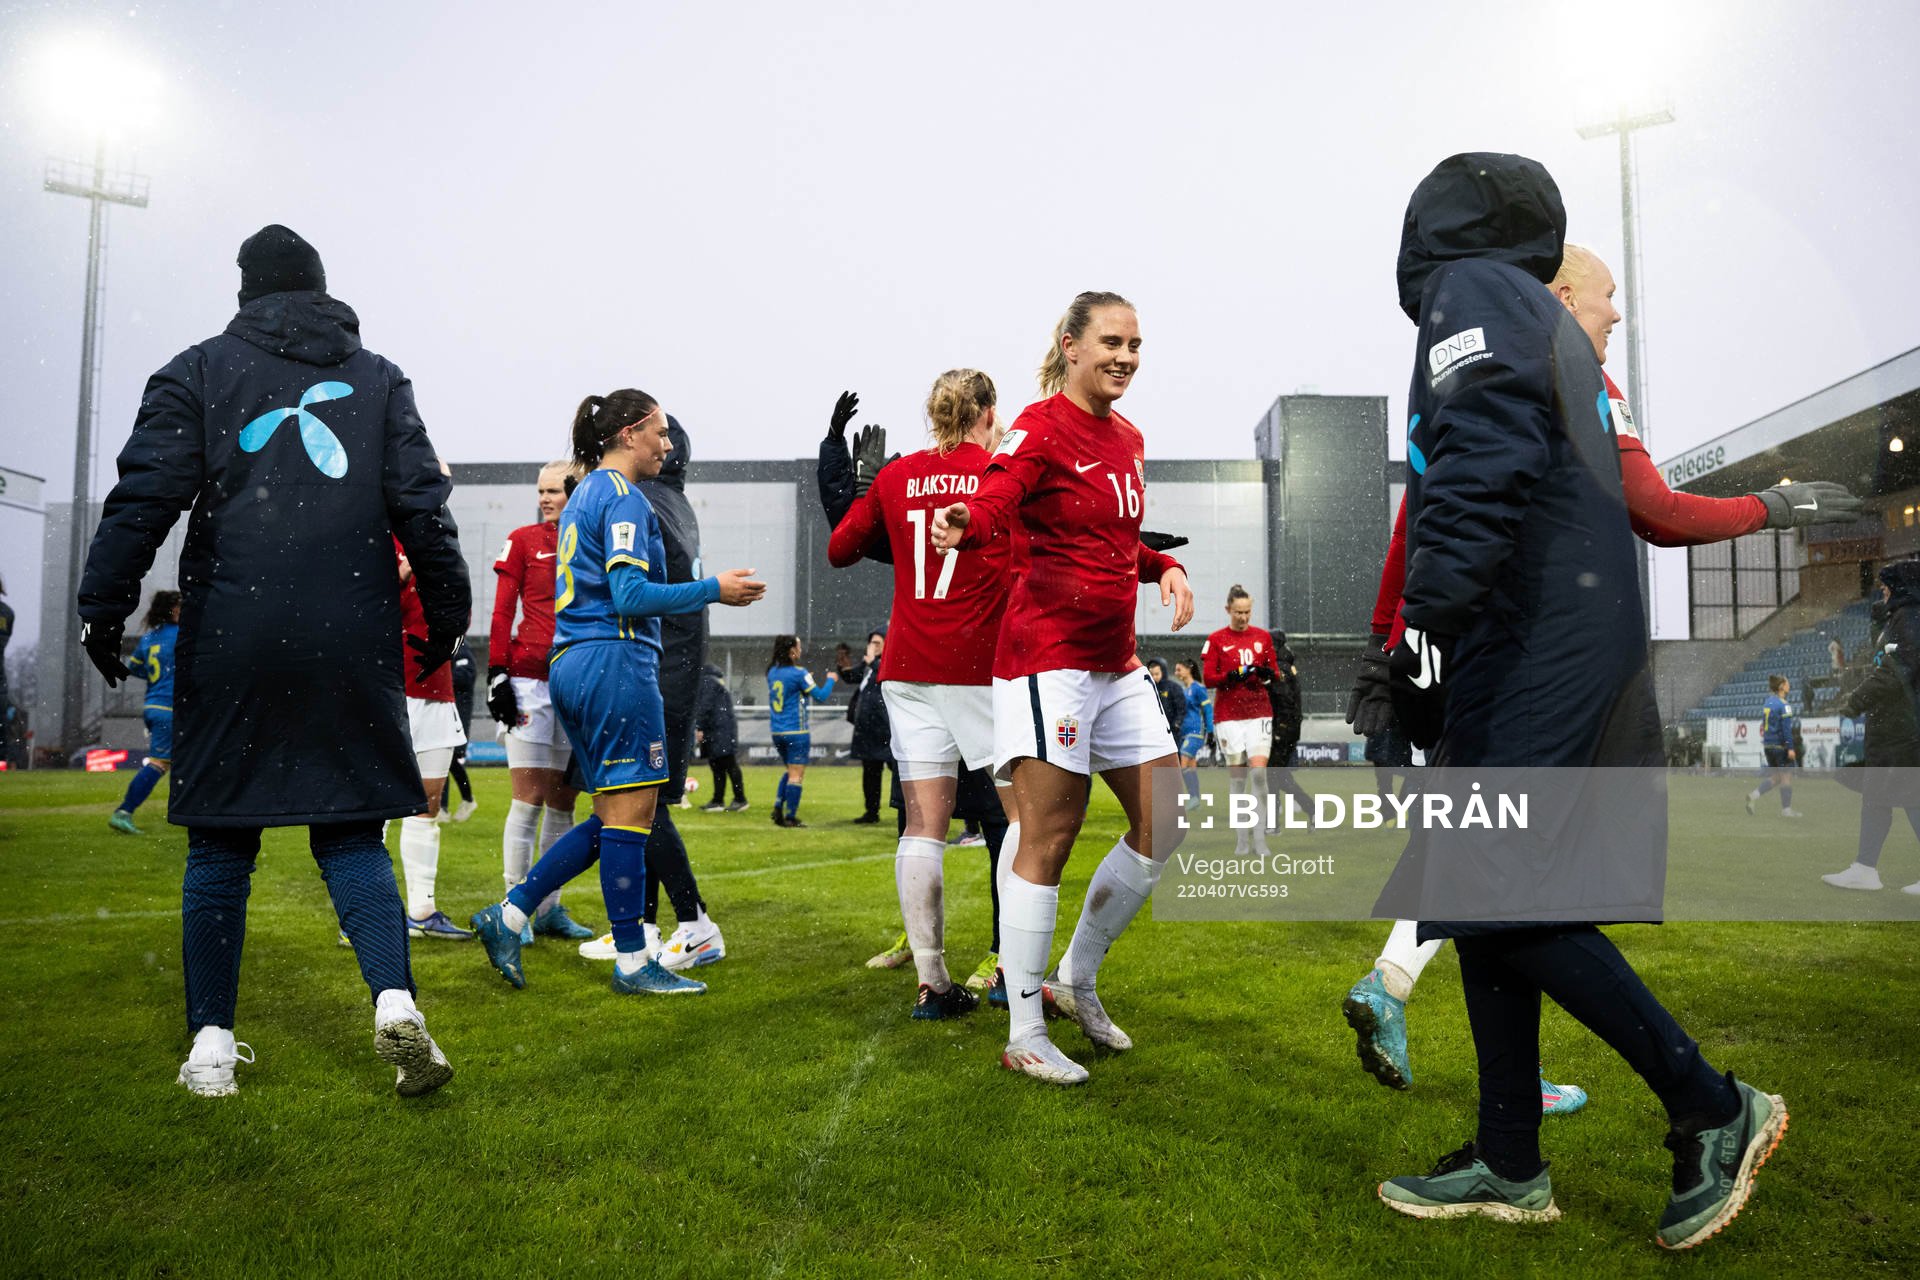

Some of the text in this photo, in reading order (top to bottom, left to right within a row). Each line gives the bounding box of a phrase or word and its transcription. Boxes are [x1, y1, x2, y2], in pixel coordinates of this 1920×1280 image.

[1435, 333, 1477, 365] DNB
[1667, 446, 1725, 487] release
[906, 474, 980, 499] BLAKSTAD
[1106, 473, 1141, 519] 16
[147, 644, 161, 684] 5
[1238, 648, 1254, 666] 10
[772, 680, 784, 713] 3
[1296, 746, 1340, 761] Tipping
